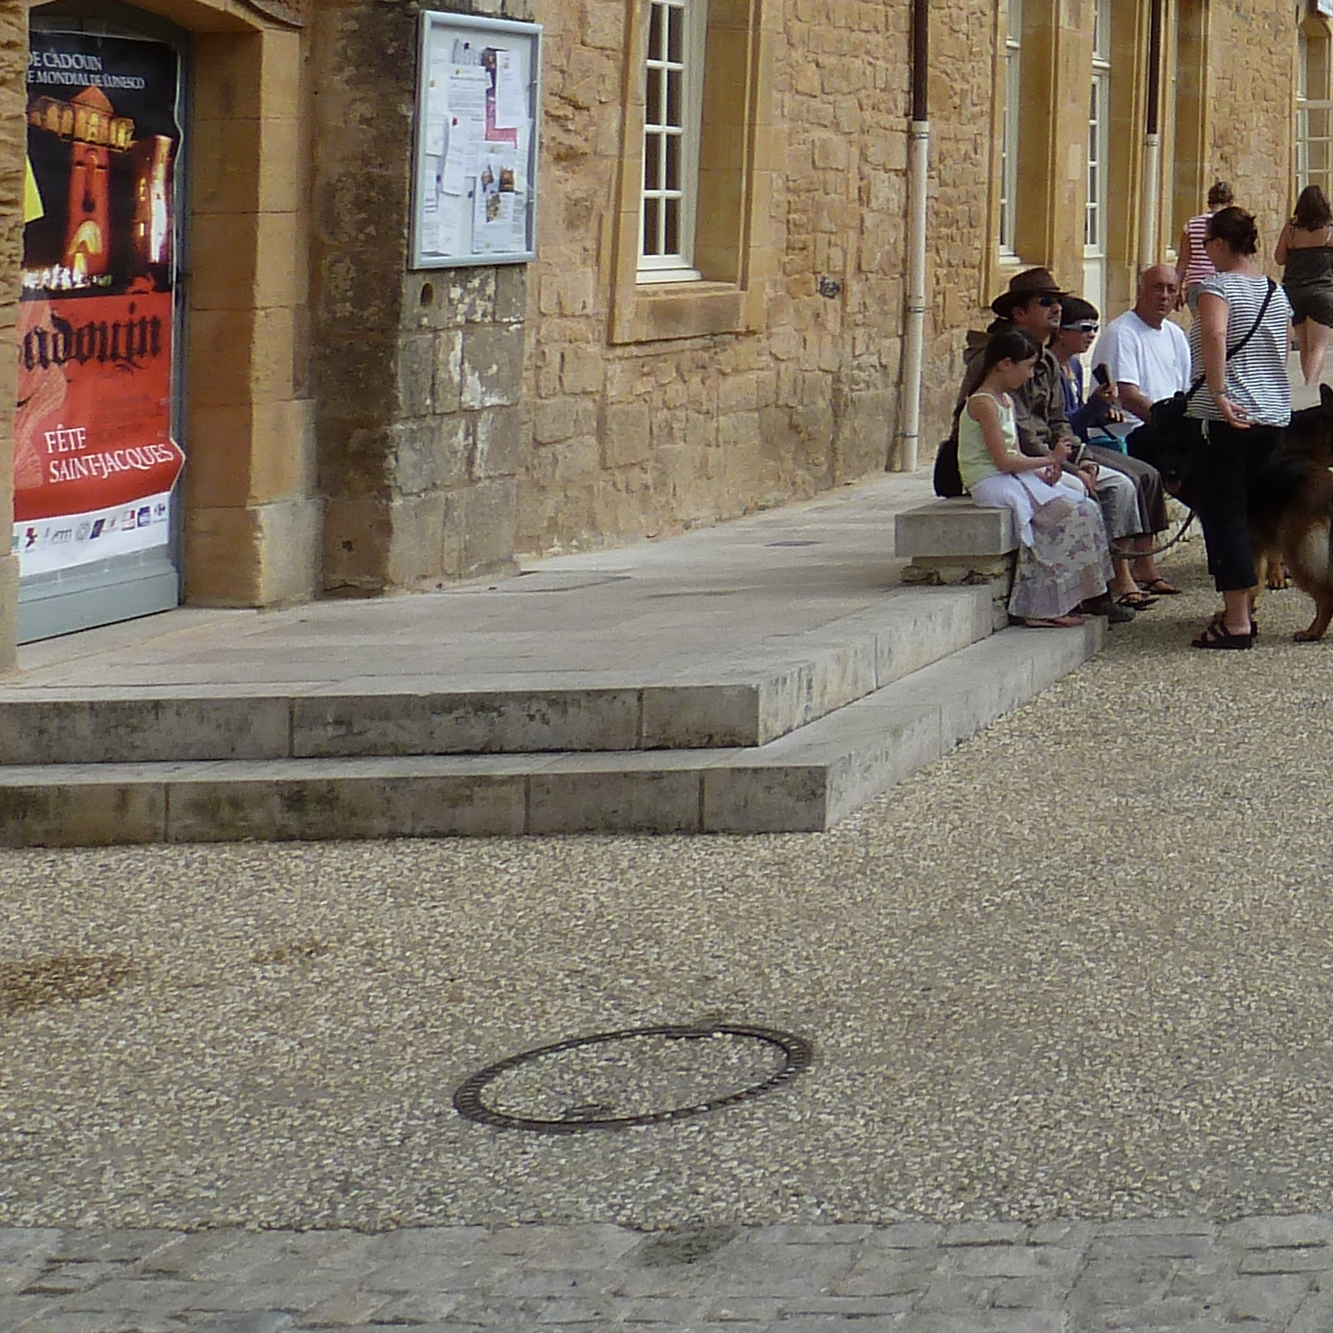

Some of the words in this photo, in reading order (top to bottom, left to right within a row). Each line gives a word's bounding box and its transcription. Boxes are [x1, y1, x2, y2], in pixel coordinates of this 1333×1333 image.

[43, 52, 102, 71] CADOUIN
[37, 71, 88, 86] MONDIAL
[88, 74, 103, 86] DE
[44, 423, 87, 454] FÊTE
[50, 443, 175, 484] SAINT-JACQUES
